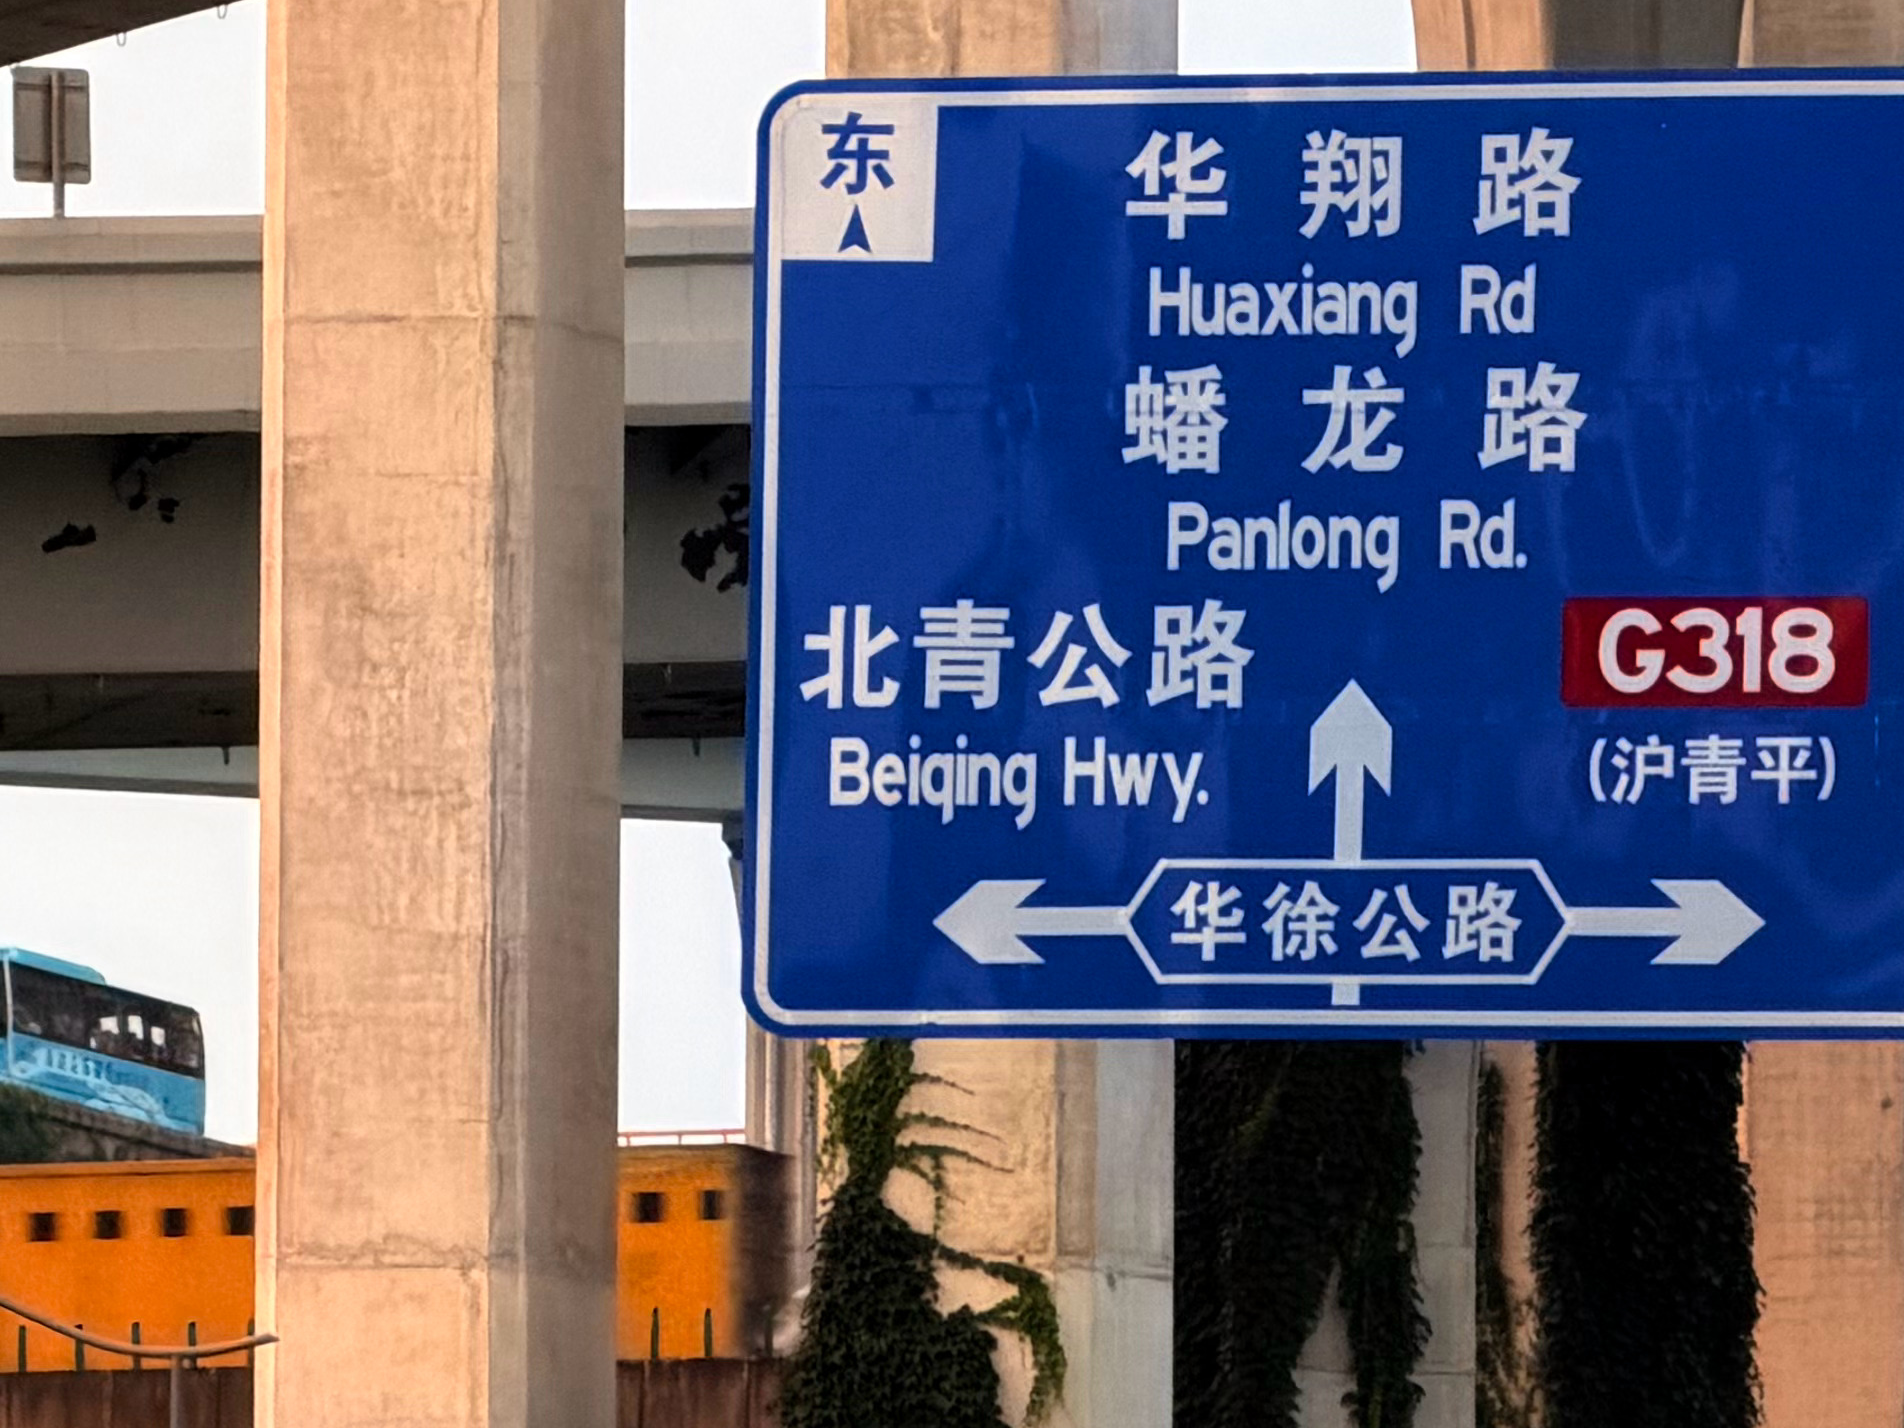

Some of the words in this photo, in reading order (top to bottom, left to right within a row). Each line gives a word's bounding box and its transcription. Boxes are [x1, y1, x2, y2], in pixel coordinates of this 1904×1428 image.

[821, 112, 894, 195] 东
[1125, 127, 1581, 240] 华翔路
[1149, 264, 1417, 358] Huaxiang
[1460, 265, 1536, 334] Rd
[1122, 362, 1587, 473] 蟠龙路
[1167, 501, 1399, 592] Panlong
[1440, 499, 1527, 568] Rd.
[799, 599, 1254, 709] 北青公路
[1598, 607, 1836, 693] G318
[829, 735, 1037, 829] Beiqing
[1063, 736, 1209, 823] Hwy.
[1589, 734, 1835, 804] (沪青平)
[1170, 880, 1521, 962] 华徐公路
